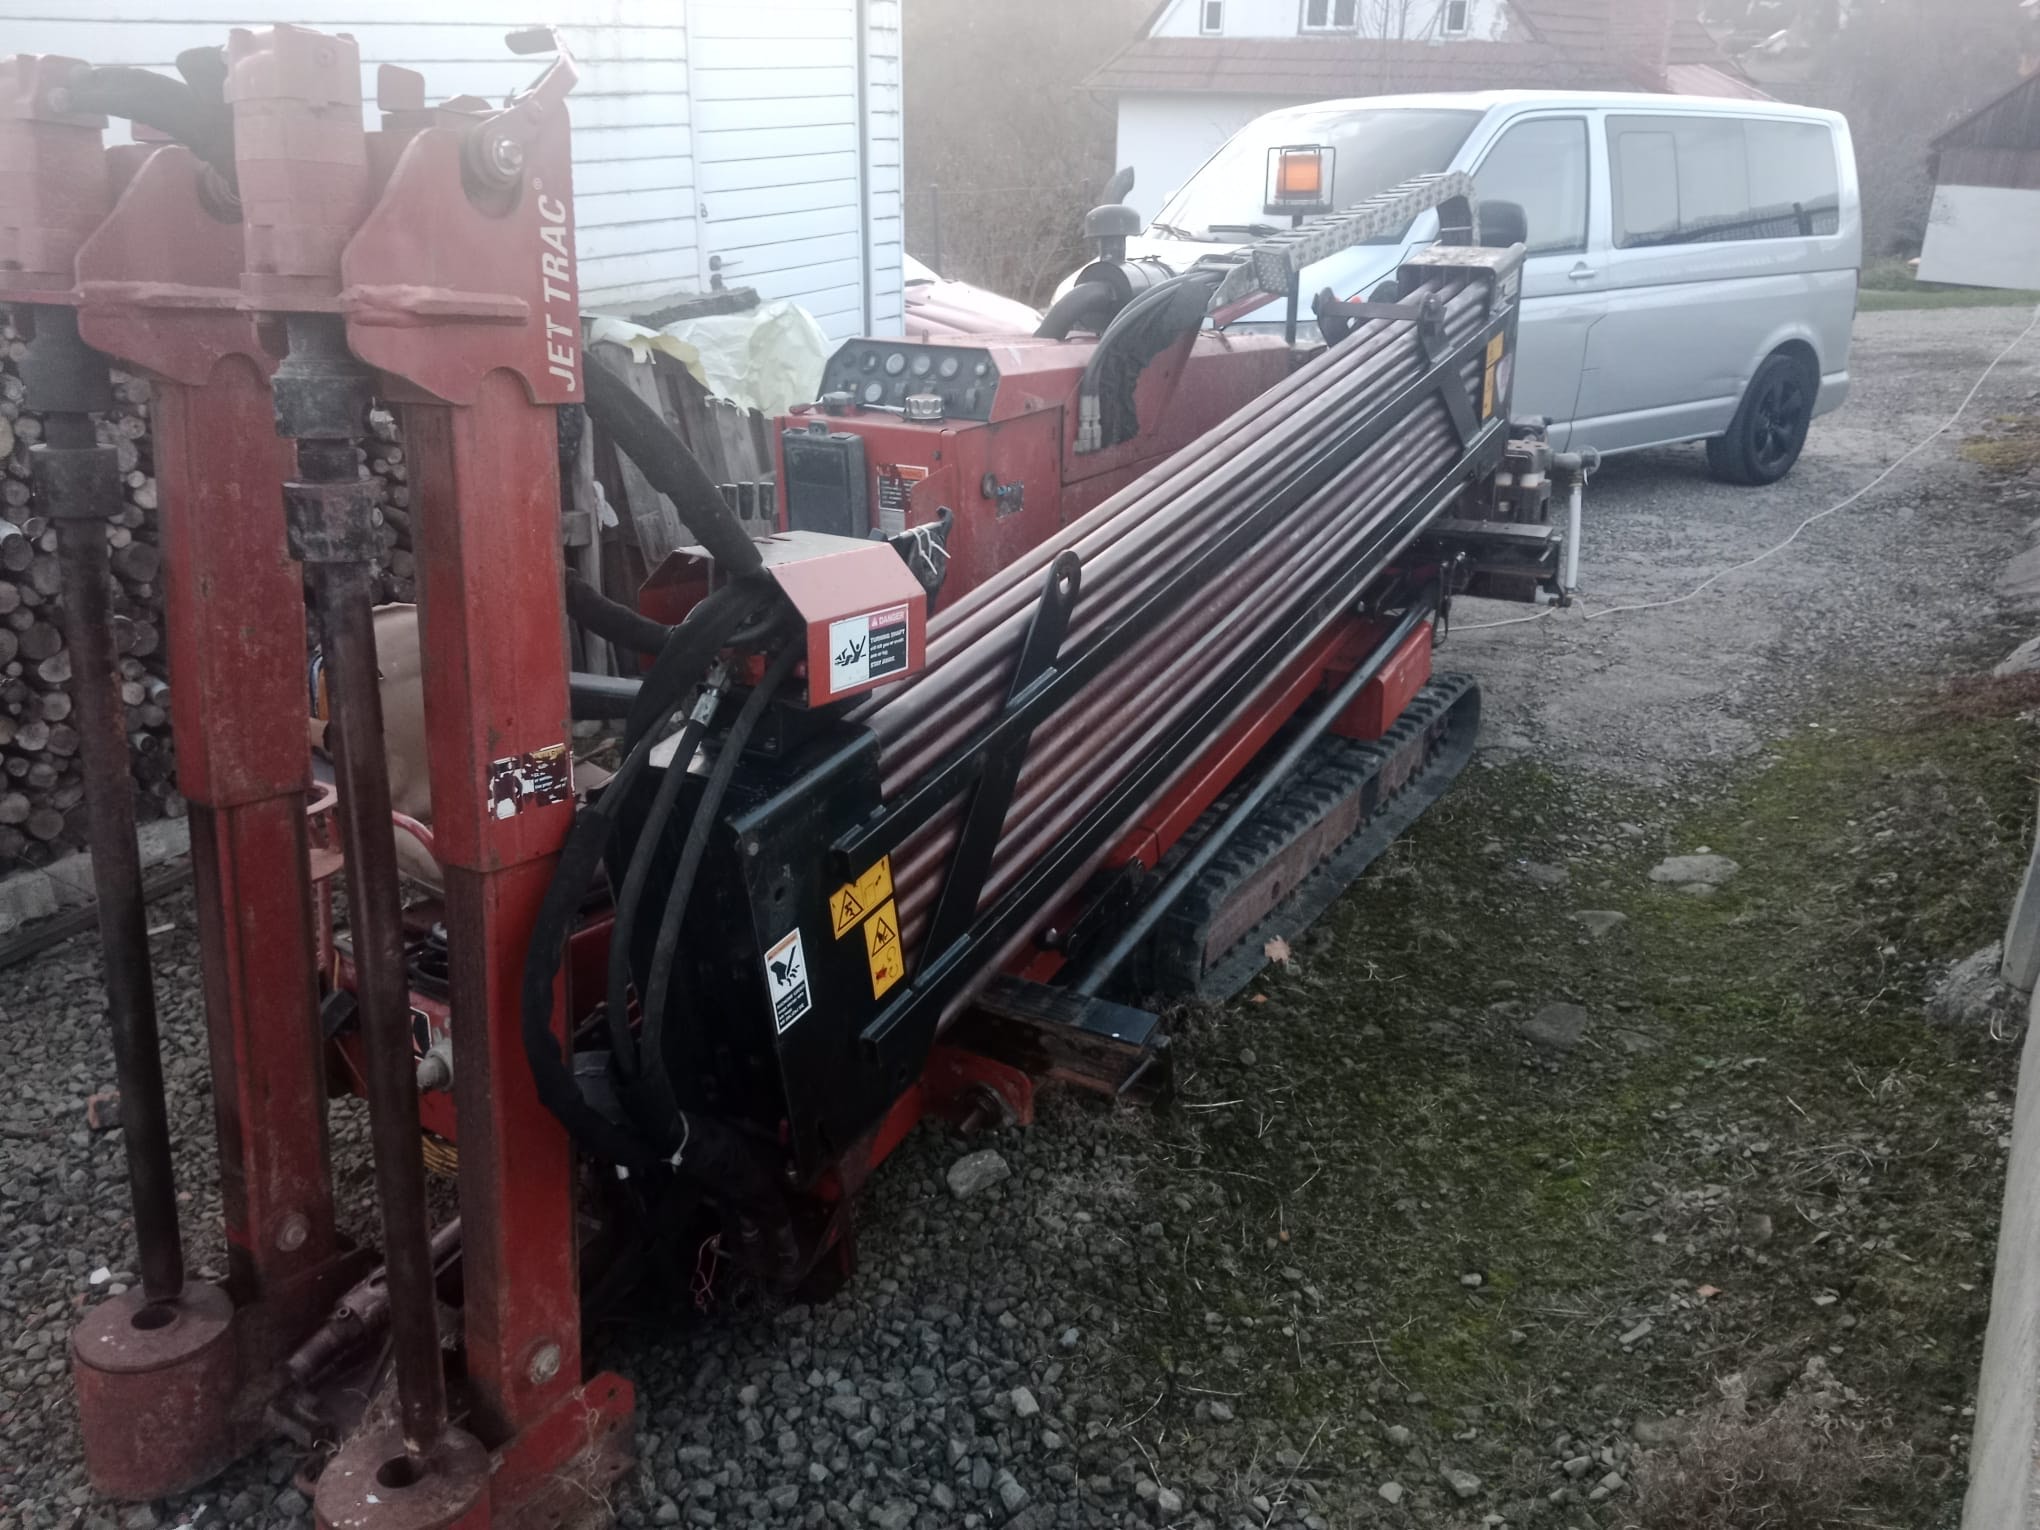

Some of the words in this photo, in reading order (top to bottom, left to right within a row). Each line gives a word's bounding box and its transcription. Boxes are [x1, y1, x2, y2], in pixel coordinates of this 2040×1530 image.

[538, 194, 570, 303] TRAC
[546, 313, 576, 392] JET
[879, 611, 904, 624] DANGER
